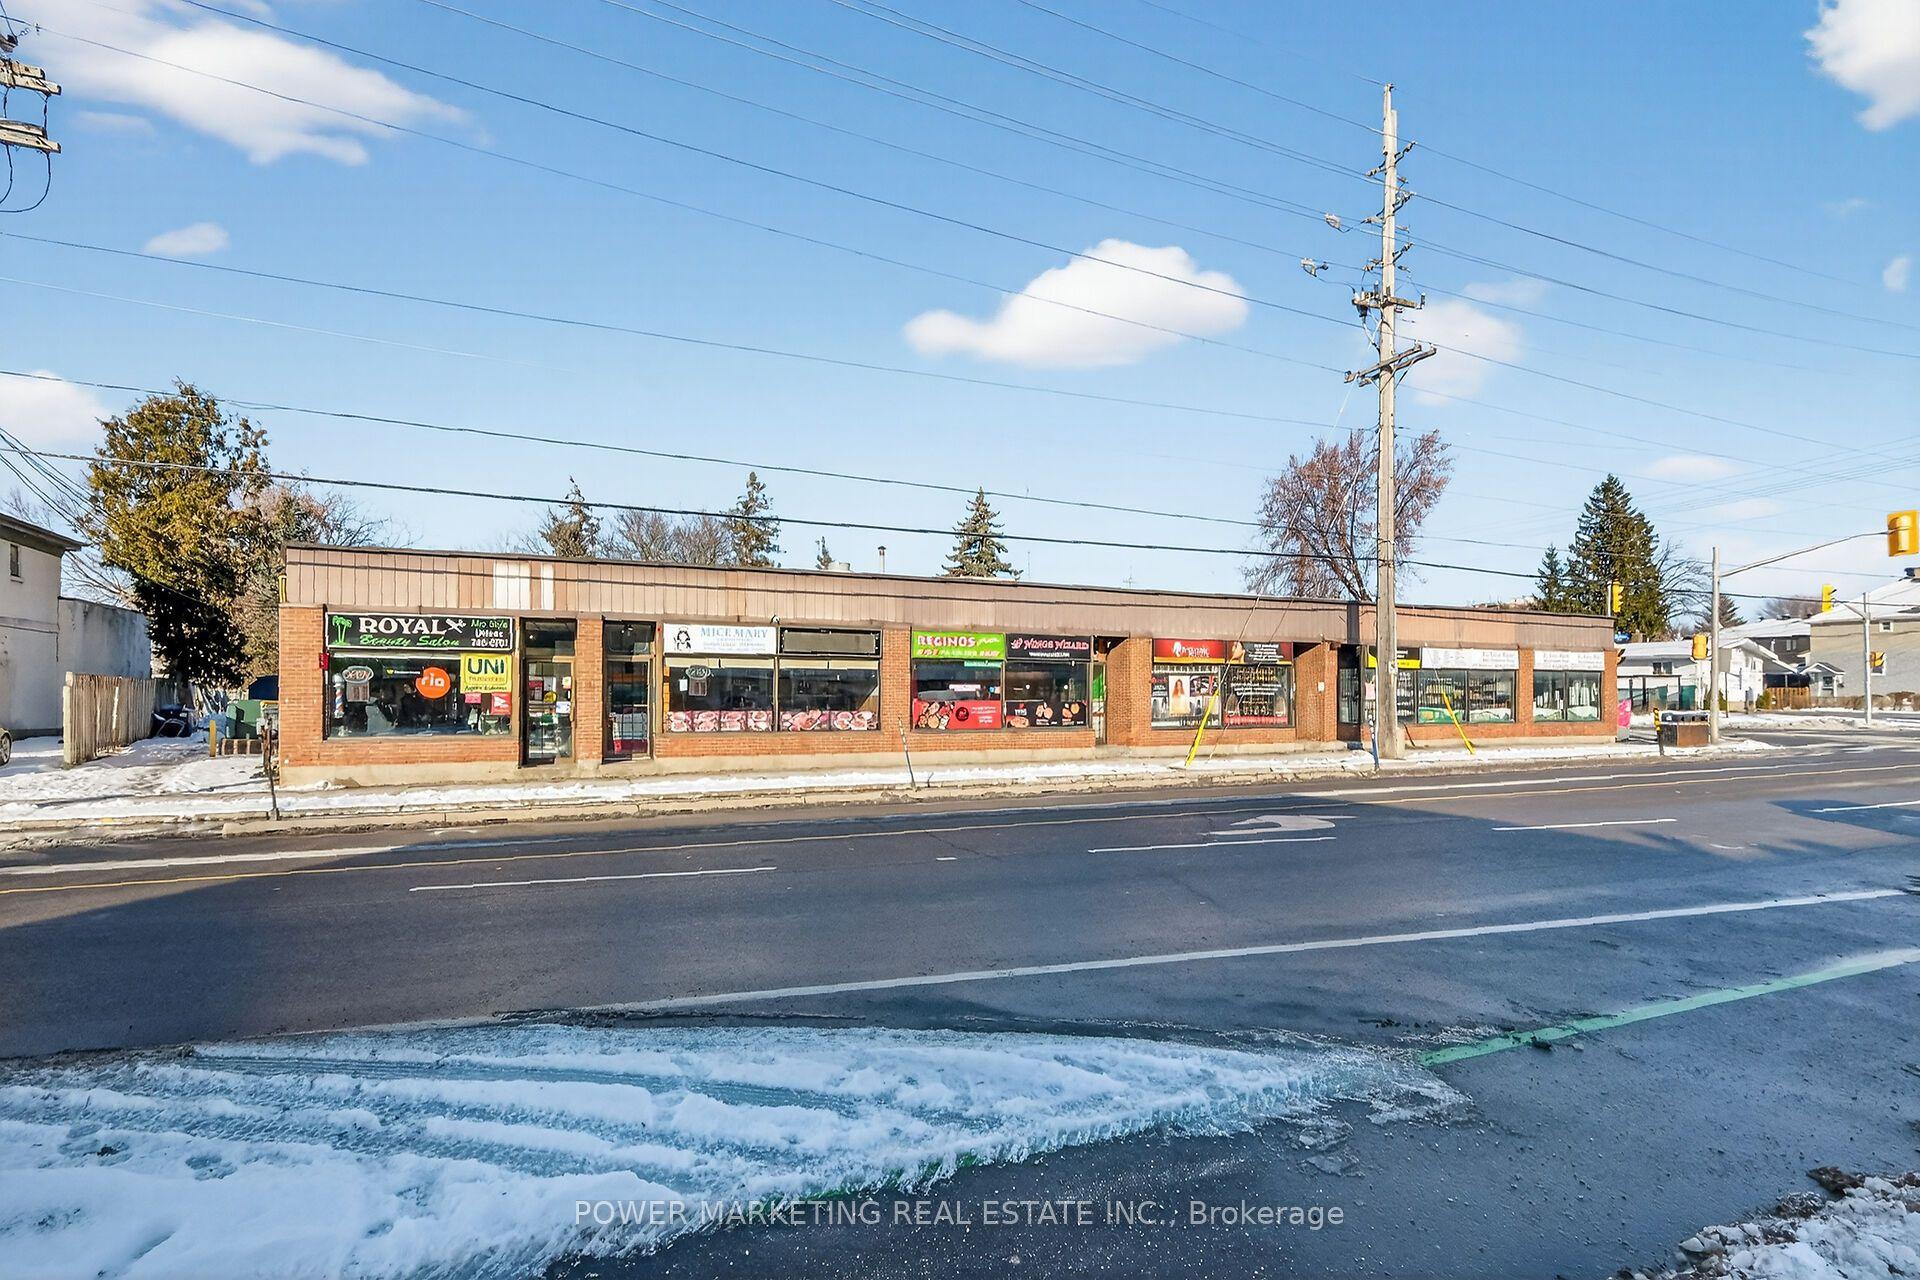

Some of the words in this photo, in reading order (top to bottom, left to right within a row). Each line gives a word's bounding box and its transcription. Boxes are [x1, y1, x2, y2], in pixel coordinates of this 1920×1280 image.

[358, 616, 447, 636] ROYAL
[467, 658, 505, 675] UNI
[421, 672, 446, 687] ria
